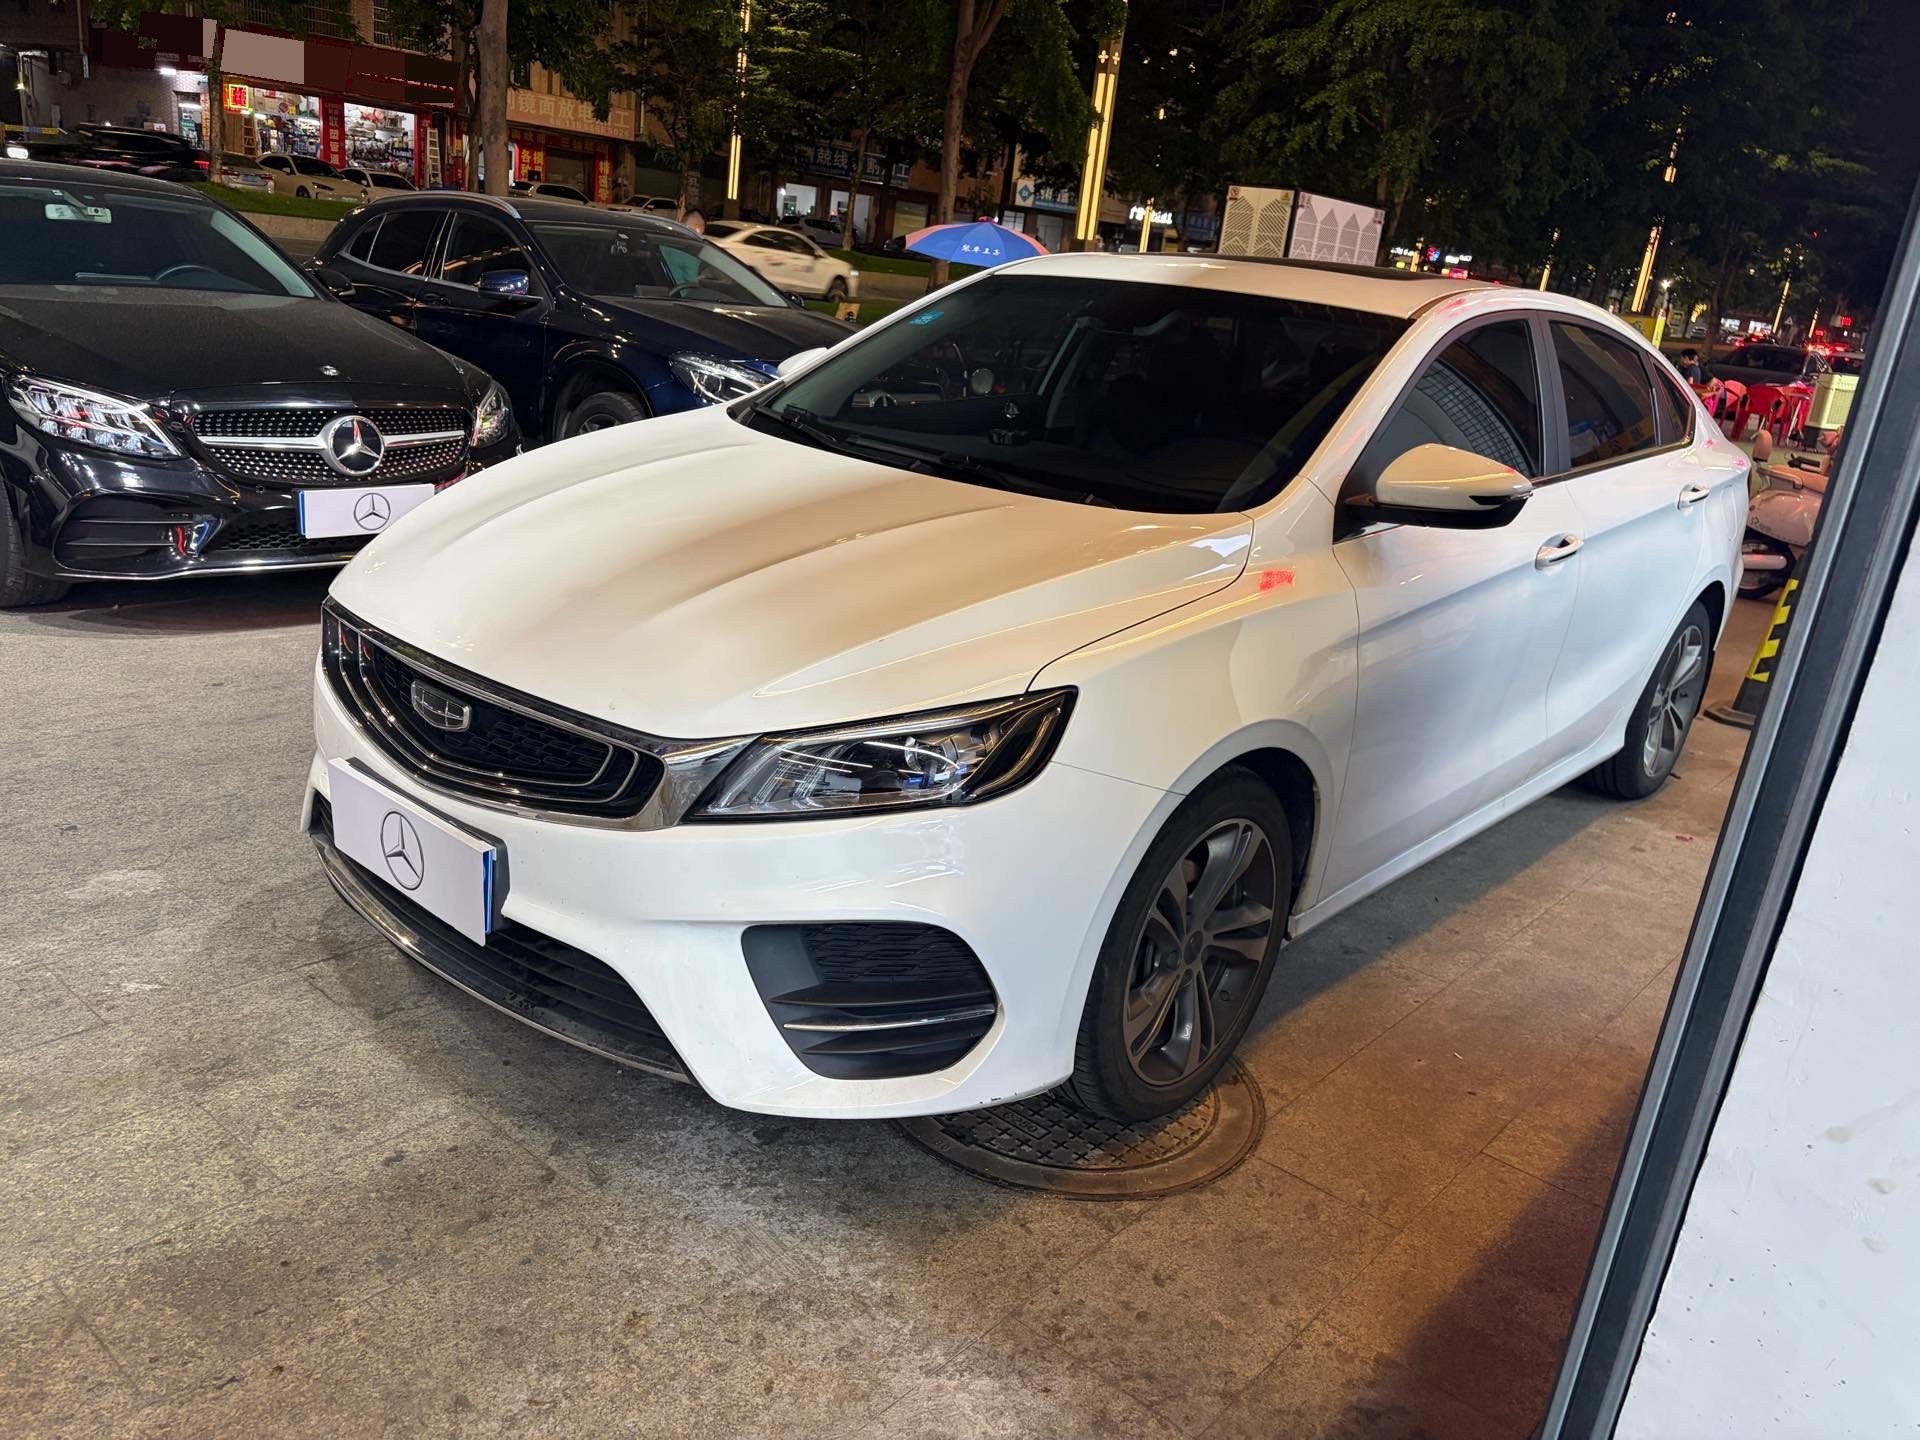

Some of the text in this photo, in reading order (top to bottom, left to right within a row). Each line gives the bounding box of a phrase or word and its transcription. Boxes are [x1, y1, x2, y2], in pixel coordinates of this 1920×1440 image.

[507, 89, 630, 128] 镜面放电工
